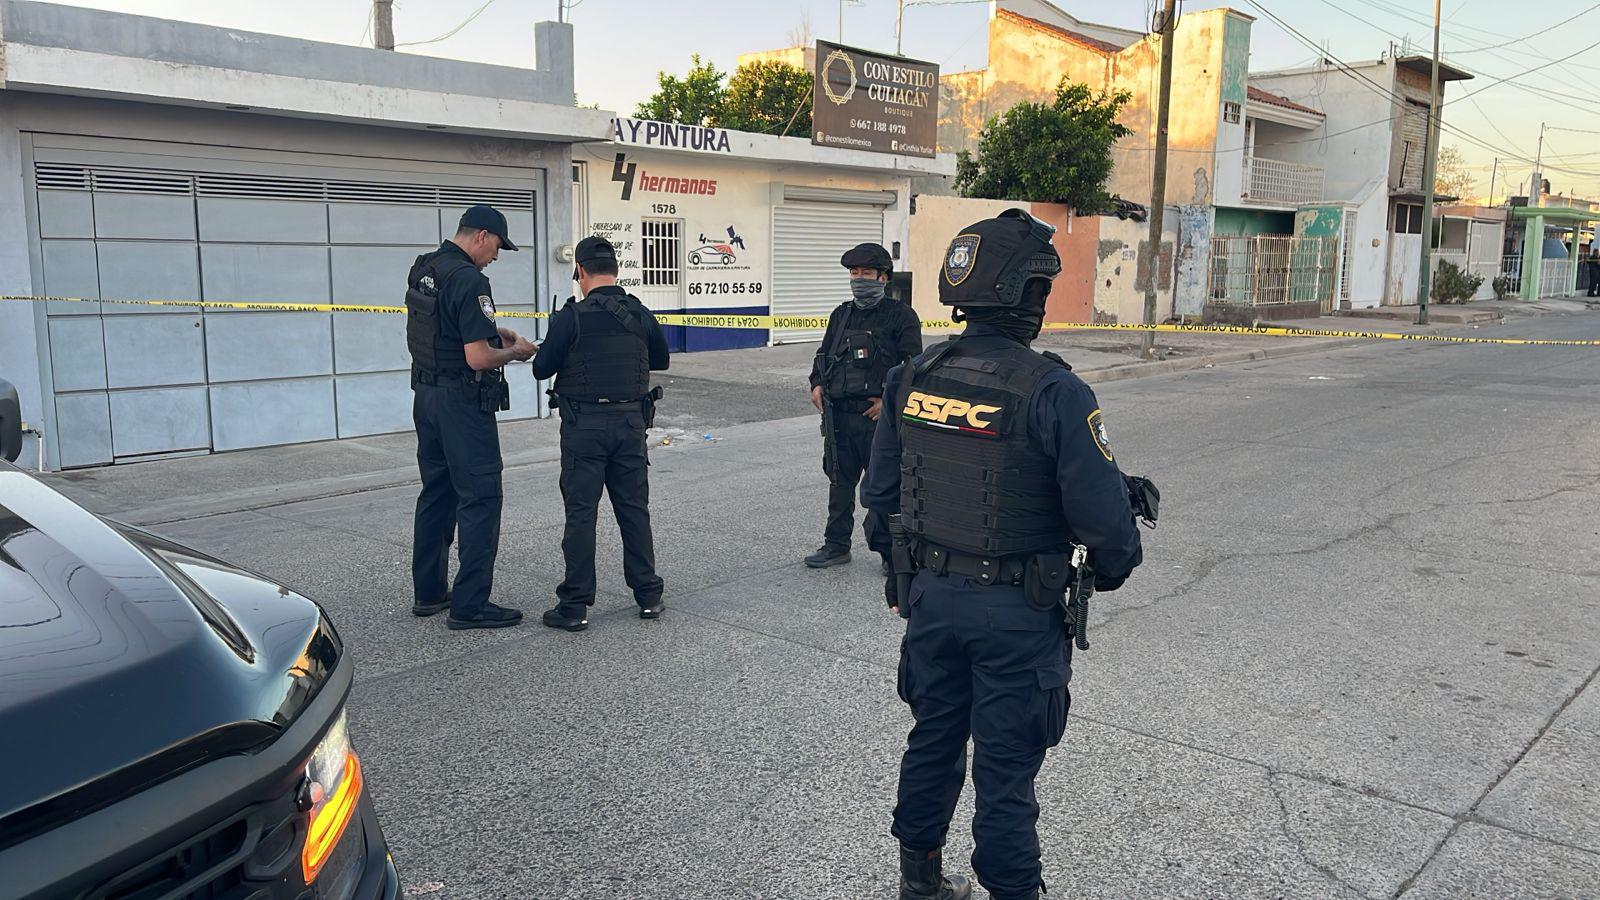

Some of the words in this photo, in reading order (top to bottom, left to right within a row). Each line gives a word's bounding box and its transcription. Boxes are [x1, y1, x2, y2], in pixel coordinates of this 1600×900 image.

[863, 61, 892, 81] CON
[892, 66, 934, 88] ESTILO
[868, 83, 929, 108] CULIACÁN
[884, 106, 913, 117] BOUTIQUE
[627, 120, 642, 143] Y
[646, 122, 731, 152] PINTURA
[857, 120, 872, 129] 667
[873, 121, 887, 131] 188
[889, 123, 906, 134] 4978
[611, 152, 637, 201] 4
[639, 171, 718, 196] hermanos
[651, 204, 677, 214] 1578
[624, 223, 633, 232] DE
[902, 391, 1002, 429] SSPC
